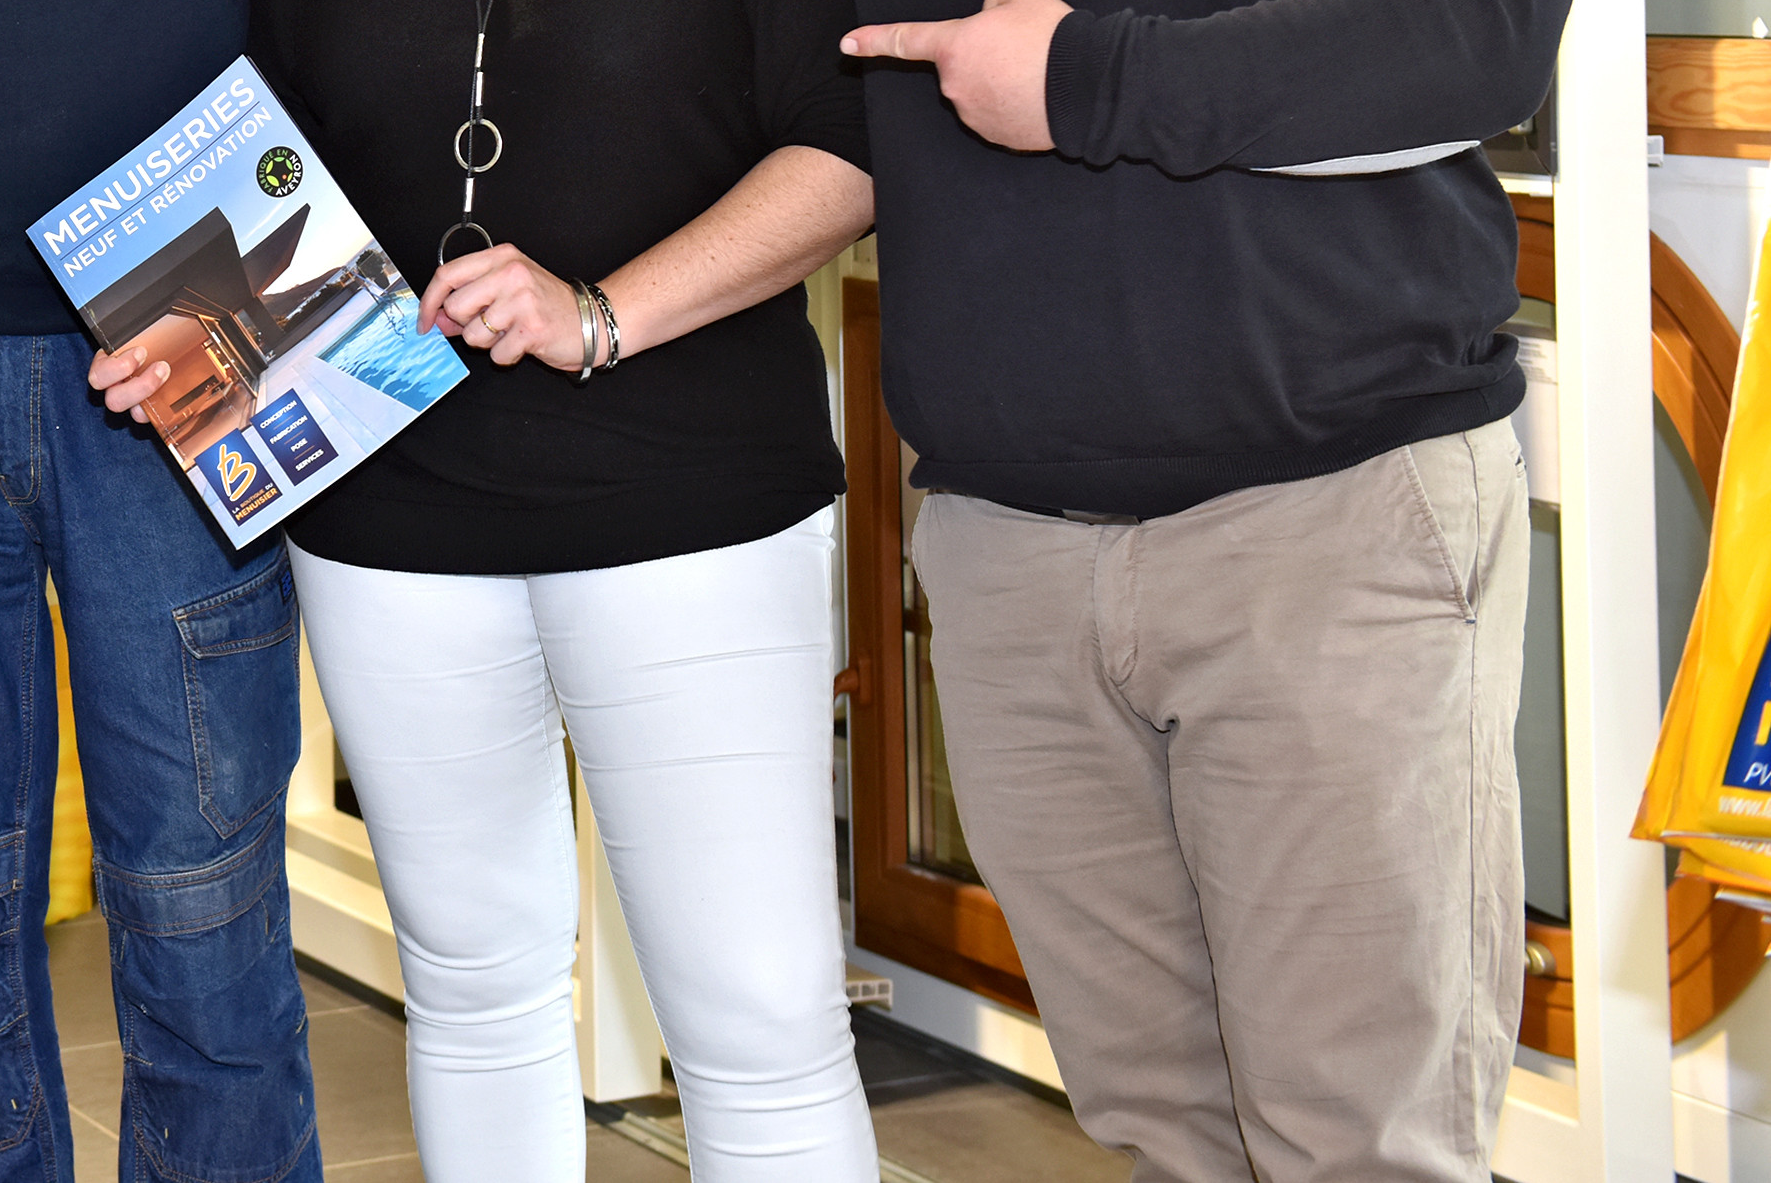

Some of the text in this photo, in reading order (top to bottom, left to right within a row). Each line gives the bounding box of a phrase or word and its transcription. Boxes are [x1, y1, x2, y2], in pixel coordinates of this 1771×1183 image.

[43, 78, 255, 256] MENUISERIES
[276, 148, 288, 156] EN
[275, 154, 302, 196] AVEYRON
[63, 106, 273, 278] NEUF ET RÉNOVATION
[259, 400, 298, 429] CONCEPTION
[269, 415, 308, 444] FABRICATION
[290, 438, 308, 452] POSE
[295, 448, 325, 471] SERVICES
[231, 506, 240, 515] LA
[264, 482, 274, 490] DU
[235, 487, 278, 521] MENUISIER
